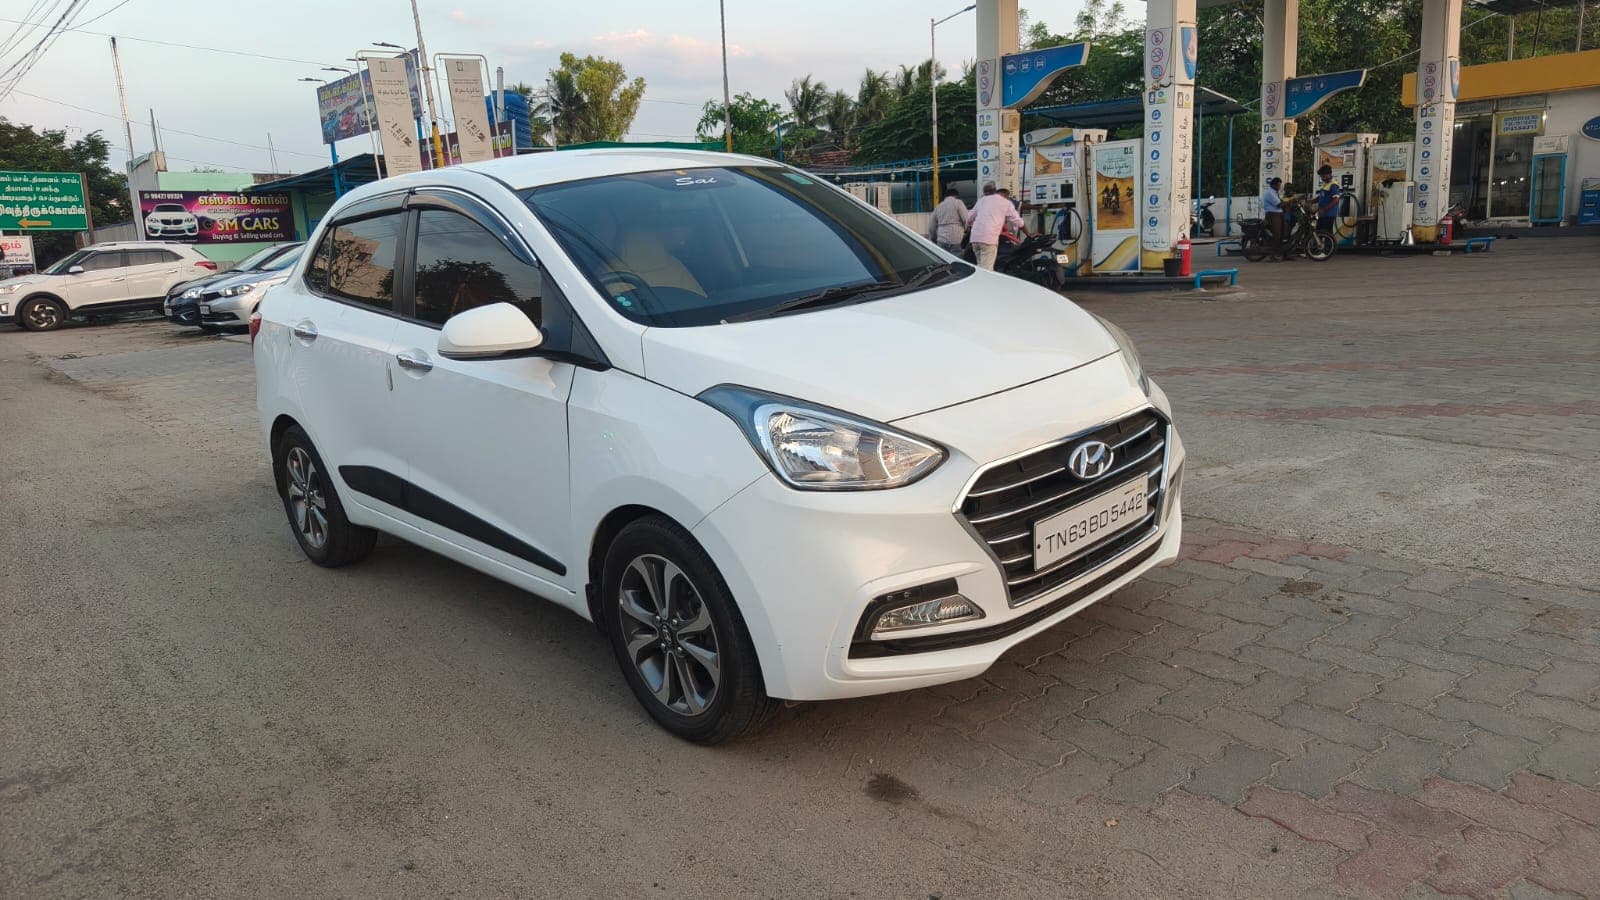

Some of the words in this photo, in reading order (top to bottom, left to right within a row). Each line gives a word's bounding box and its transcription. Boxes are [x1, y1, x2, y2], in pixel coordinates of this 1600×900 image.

[216, 217, 239, 231] SM
[241, 216, 280, 231] CARS
[212, 233, 233, 241] Buying
[240, 232, 259, 240] Selling
[1044, 492, 1143, 553] TN63BD5442
